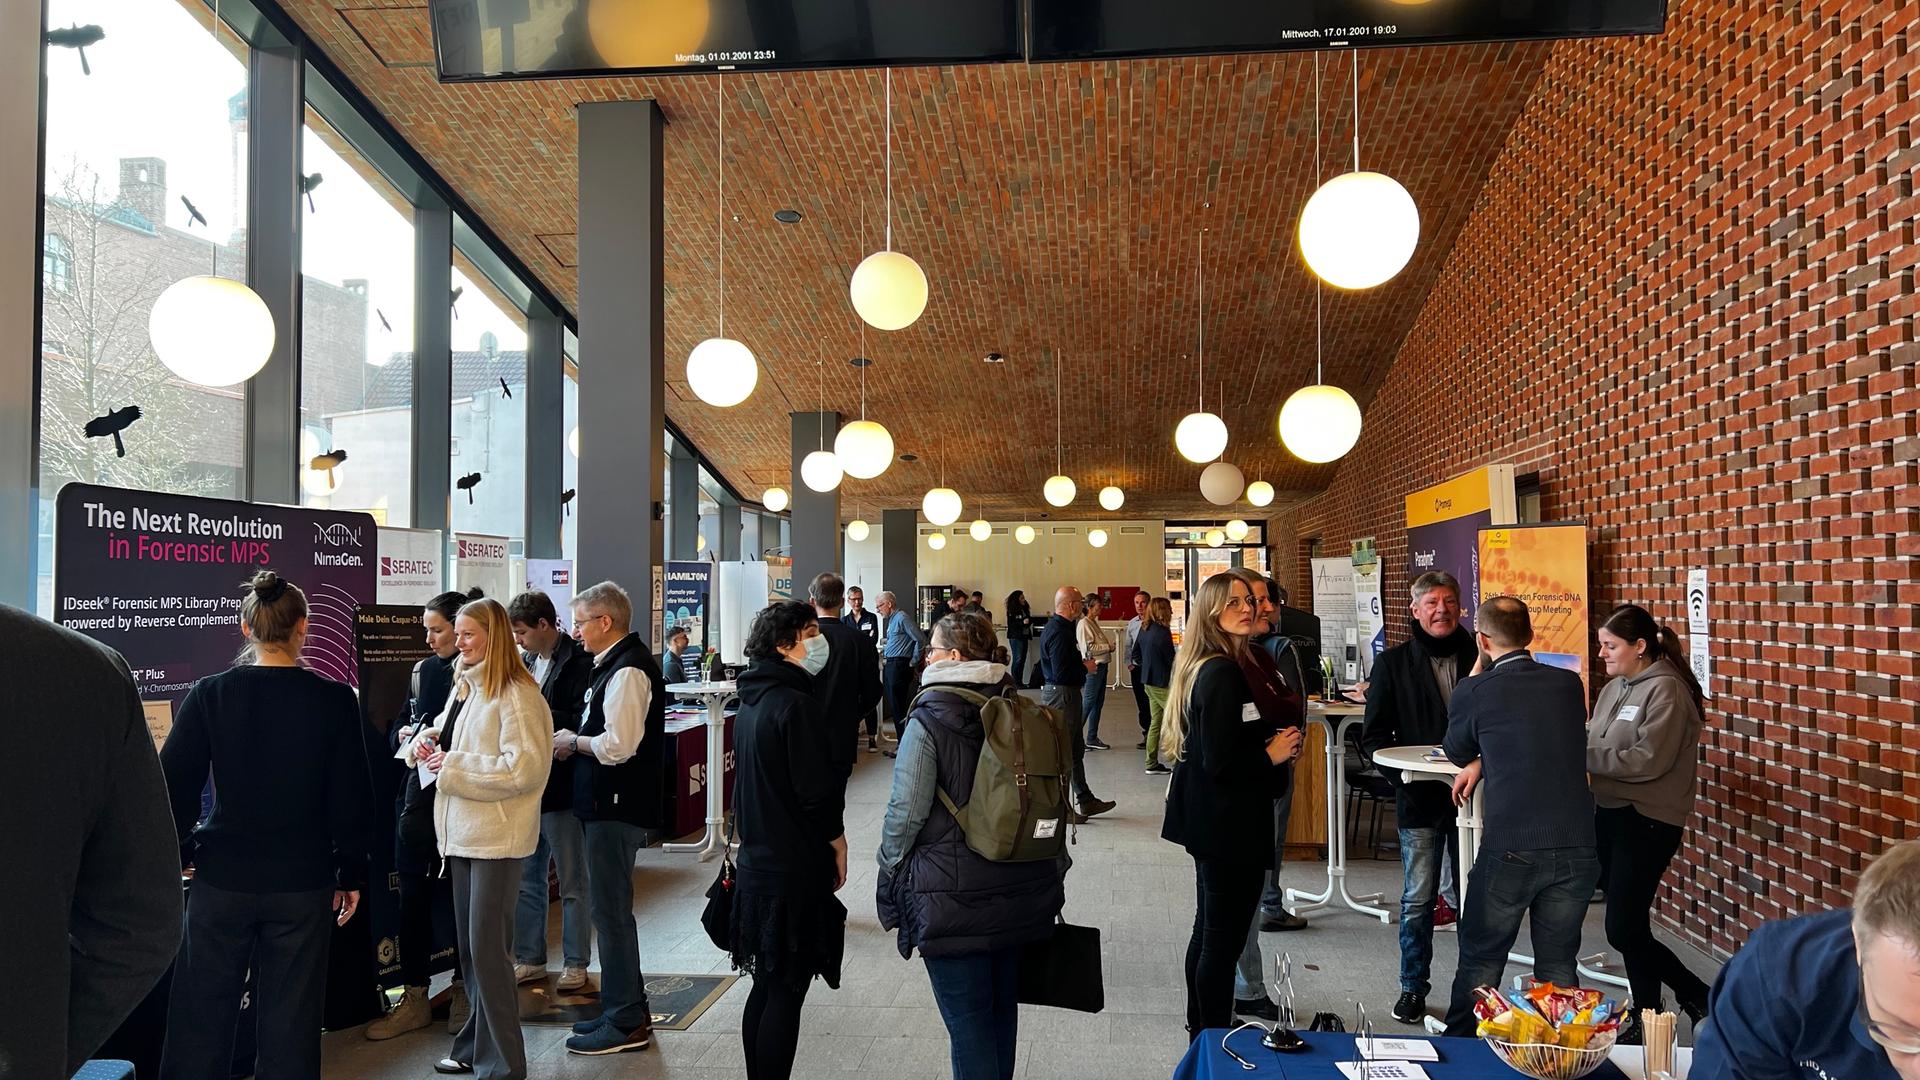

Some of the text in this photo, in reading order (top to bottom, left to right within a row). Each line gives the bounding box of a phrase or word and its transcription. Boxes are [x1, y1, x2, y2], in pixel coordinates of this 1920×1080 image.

[1282, 25, 1397, 39] Mittwoch, 17.01.2001 19:03
[675, 51, 776, 63] Montag, 01.01.2001 23:51
[83, 503, 282, 540] The Next Revolution
[109, 533, 271, 565] in Forensic MPS
[467, 543, 504, 559] SERATEC
[392, 560, 434, 574] SERATEC
[112, 597, 158, 610] Forensic
[161, 597, 182, 610] MPS
[185, 597, 219, 612] Library
[221, 597, 242, 612] Prep
[1533, 593, 1562, 602] Forensic
[1565, 593, 1582, 602] DNA
[1529, 604, 1571, 616] oup Meeting
[63, 614, 239, 631] powered by Reverse Complement
[145, 668, 166, 681] Plus
